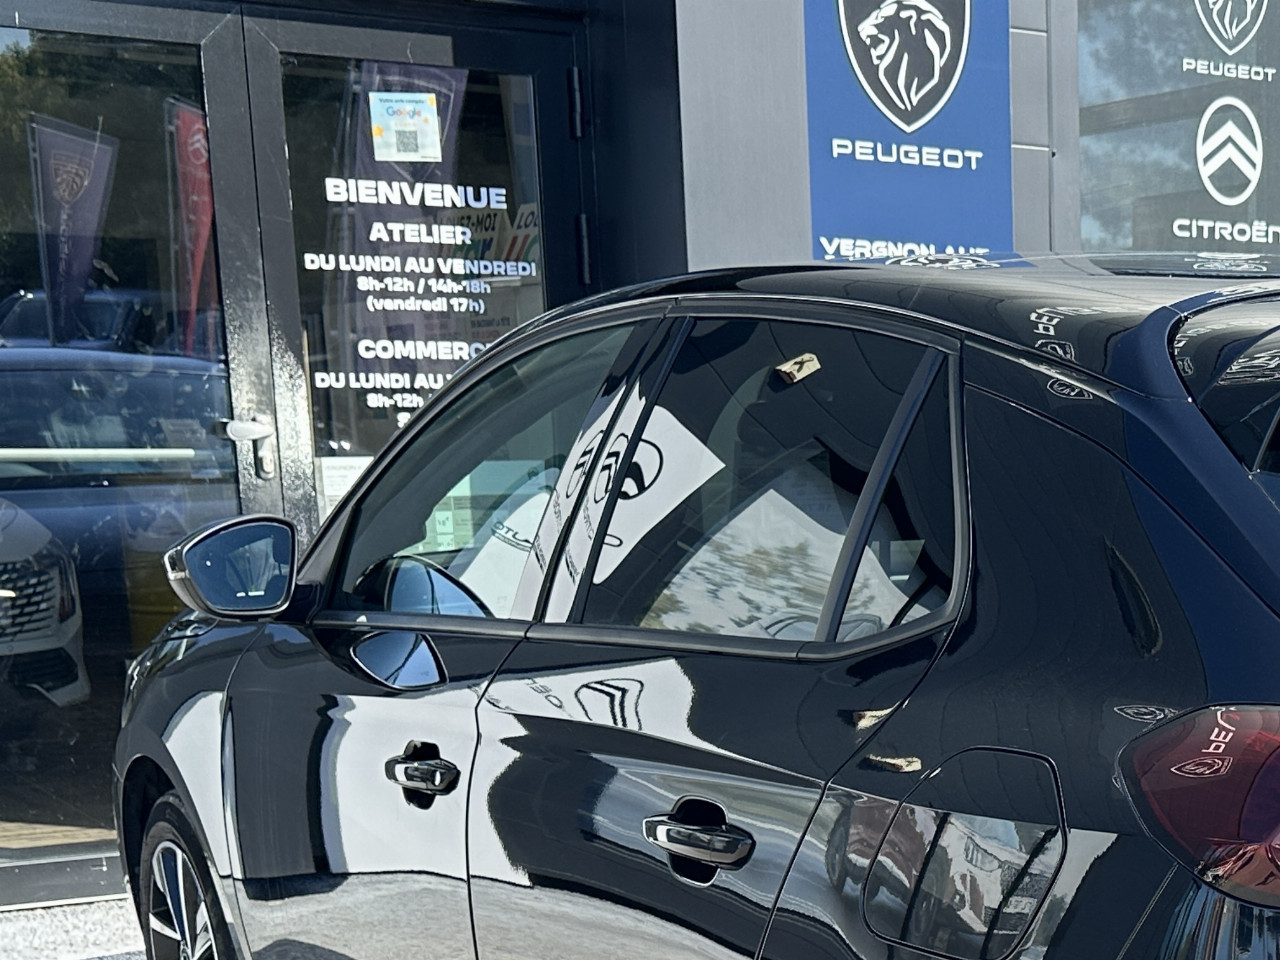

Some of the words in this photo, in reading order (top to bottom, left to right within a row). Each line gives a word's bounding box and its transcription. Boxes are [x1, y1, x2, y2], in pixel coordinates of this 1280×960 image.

[1182, 57, 1277, 82] PEUGEOT
[832, 138, 984, 171] PEUGEOT
[325, 177, 507, 210] BIENVENUE
[369, 222, 472, 245] ATELIER
[819, 236, 936, 258] VERGNON
[303, 253, 335, 271] DU
[338, 254, 401, 273] LUNDI
[404, 257, 434, 275] AU
[437, 258, 537, 277] VENDREDI
[356, 275, 415, 293] 8h-12h
[427, 278, 491, 294] 14h-18h
[366, 295, 447, 312] (vendredi
[449, 298, 485, 314] 17h)
[314, 372, 345, 389] DU
[349, 372, 410, 389] LUNDI
[414, 373, 443, 390] AU
[366, 393, 424, 409] 8h-12h
